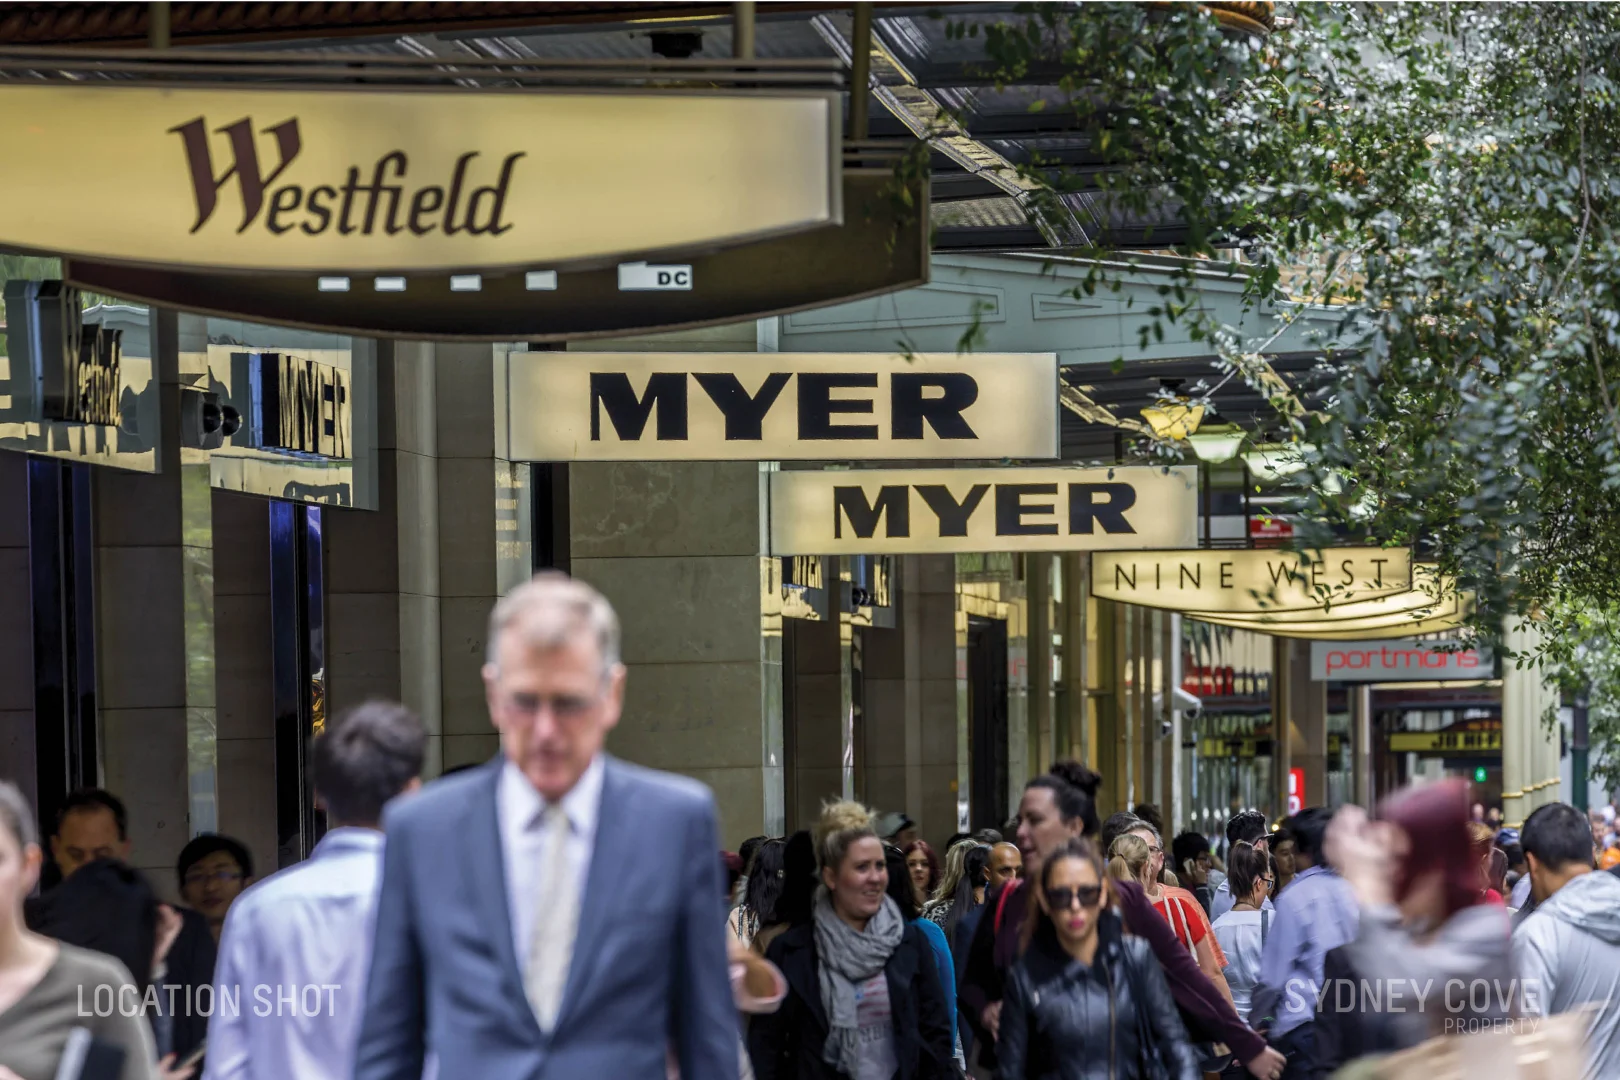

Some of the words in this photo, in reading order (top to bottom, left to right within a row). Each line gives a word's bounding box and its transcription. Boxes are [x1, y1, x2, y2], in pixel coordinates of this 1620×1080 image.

[166, 115, 527, 236] Westfield
[657, 271, 688, 285] DC
[590, 372, 978, 441] MYER
[833, 482, 1137, 539] MYER
[1114, 562, 1234, 590] NINE
[1266, 559, 1389, 587] WEST
[1326, 646, 1479, 676] portmans
